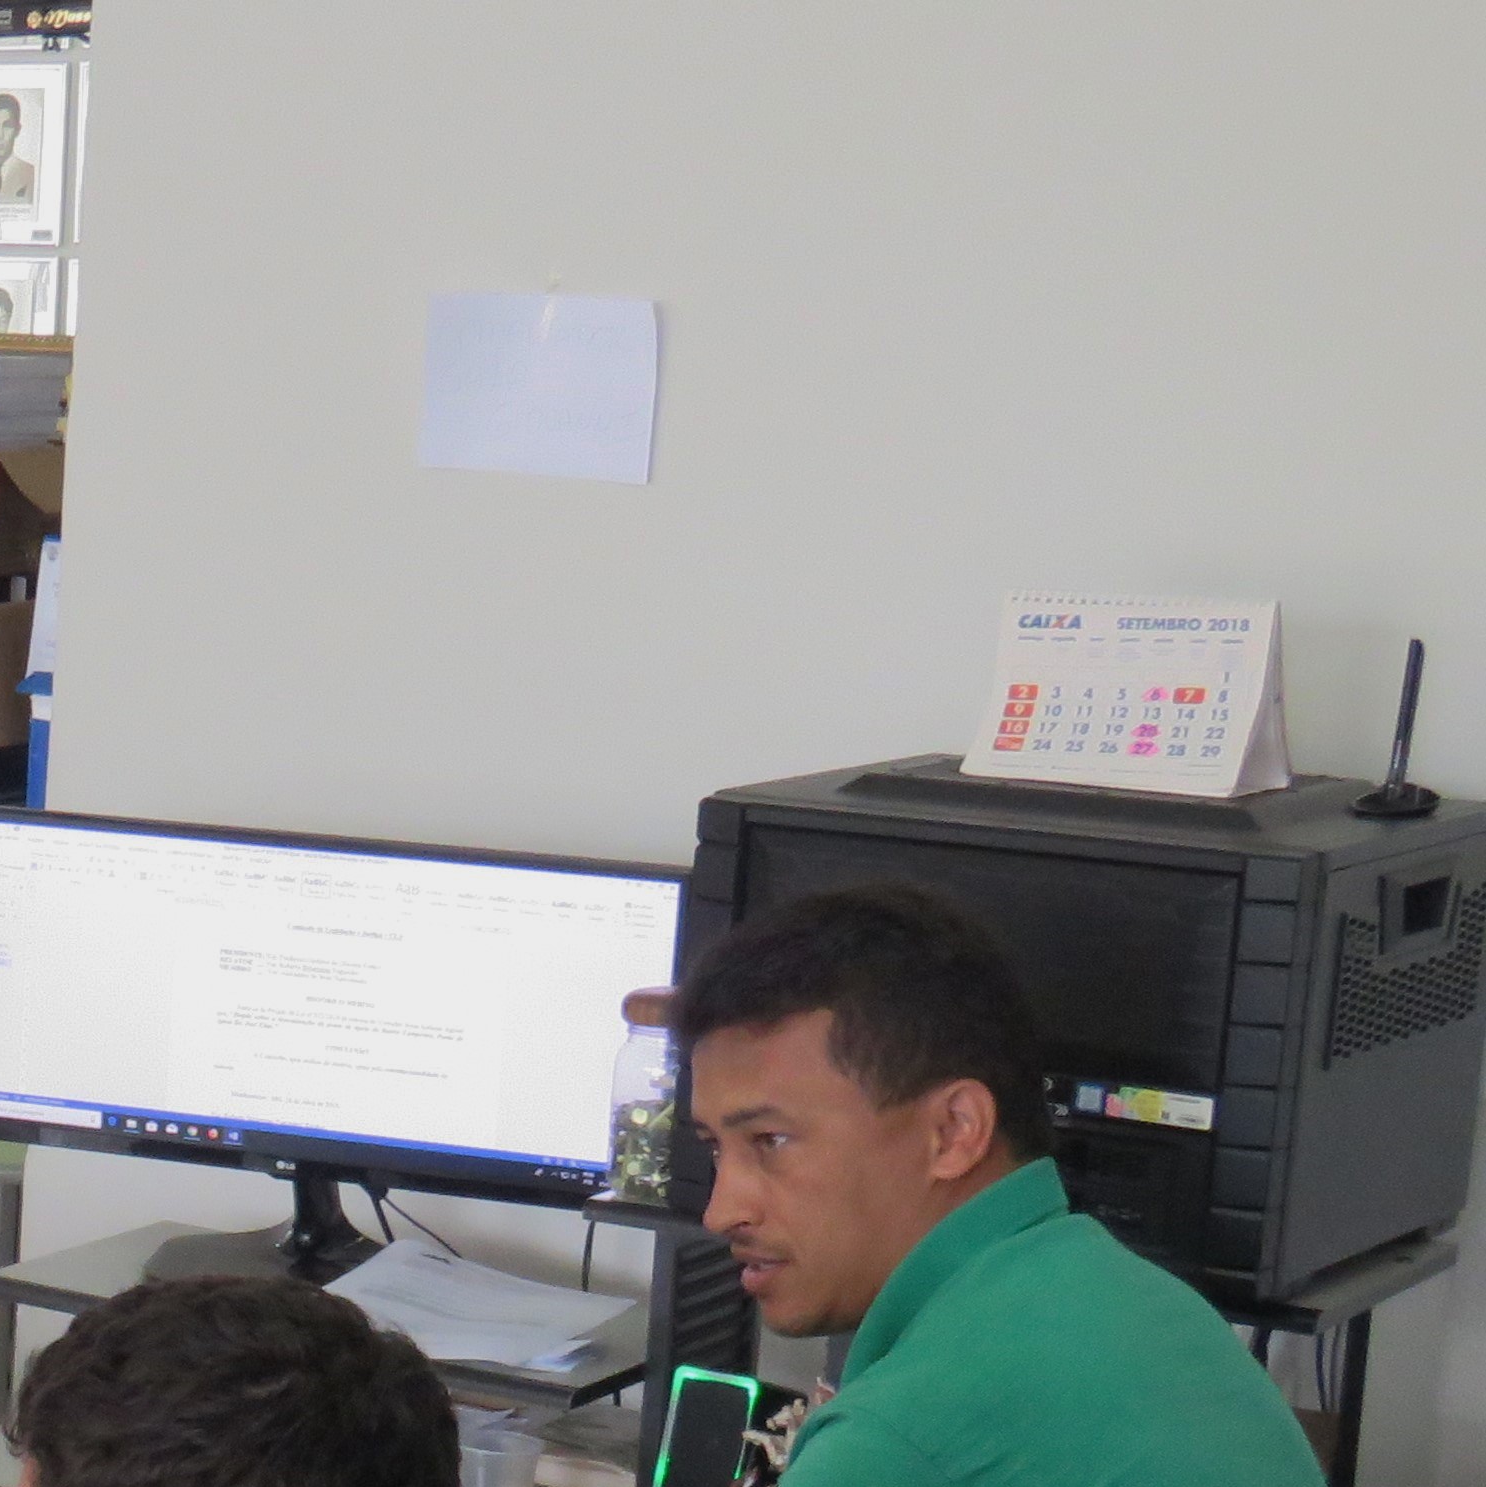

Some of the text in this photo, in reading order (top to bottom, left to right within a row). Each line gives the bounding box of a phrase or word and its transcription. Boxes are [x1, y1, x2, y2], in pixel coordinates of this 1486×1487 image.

[1017, 614, 1250, 632] CAIXA SETEMBRO 2018
[1017, 685, 1029, 698] 2
[1050, 686, 1061, 699] 3
[1082, 688, 1094, 699] 4
[1117, 688, 1126, 700] 5
[1183, 689, 1195, 702] 7
[1013, 703, 1228, 721] 9 10 11 12 13 14 15
[1006, 721, 1024, 733] 16
[1039, 722, 1058, 734] 17
[1072, 723, 1090, 735] 18
[1105, 724, 1124, 736] 19
[1171, 726, 1189, 738] 21
[1204, 727, 1224, 739] 22
[1032, 739, 1052, 751] 24
[1065, 740, 1084, 752] 25
[1098, 741, 1118, 754] 26
[1133, 743, 1151, 755] 27
[1166, 744, 1186, 757] 28
[1200, 745, 1220, 758] 29
